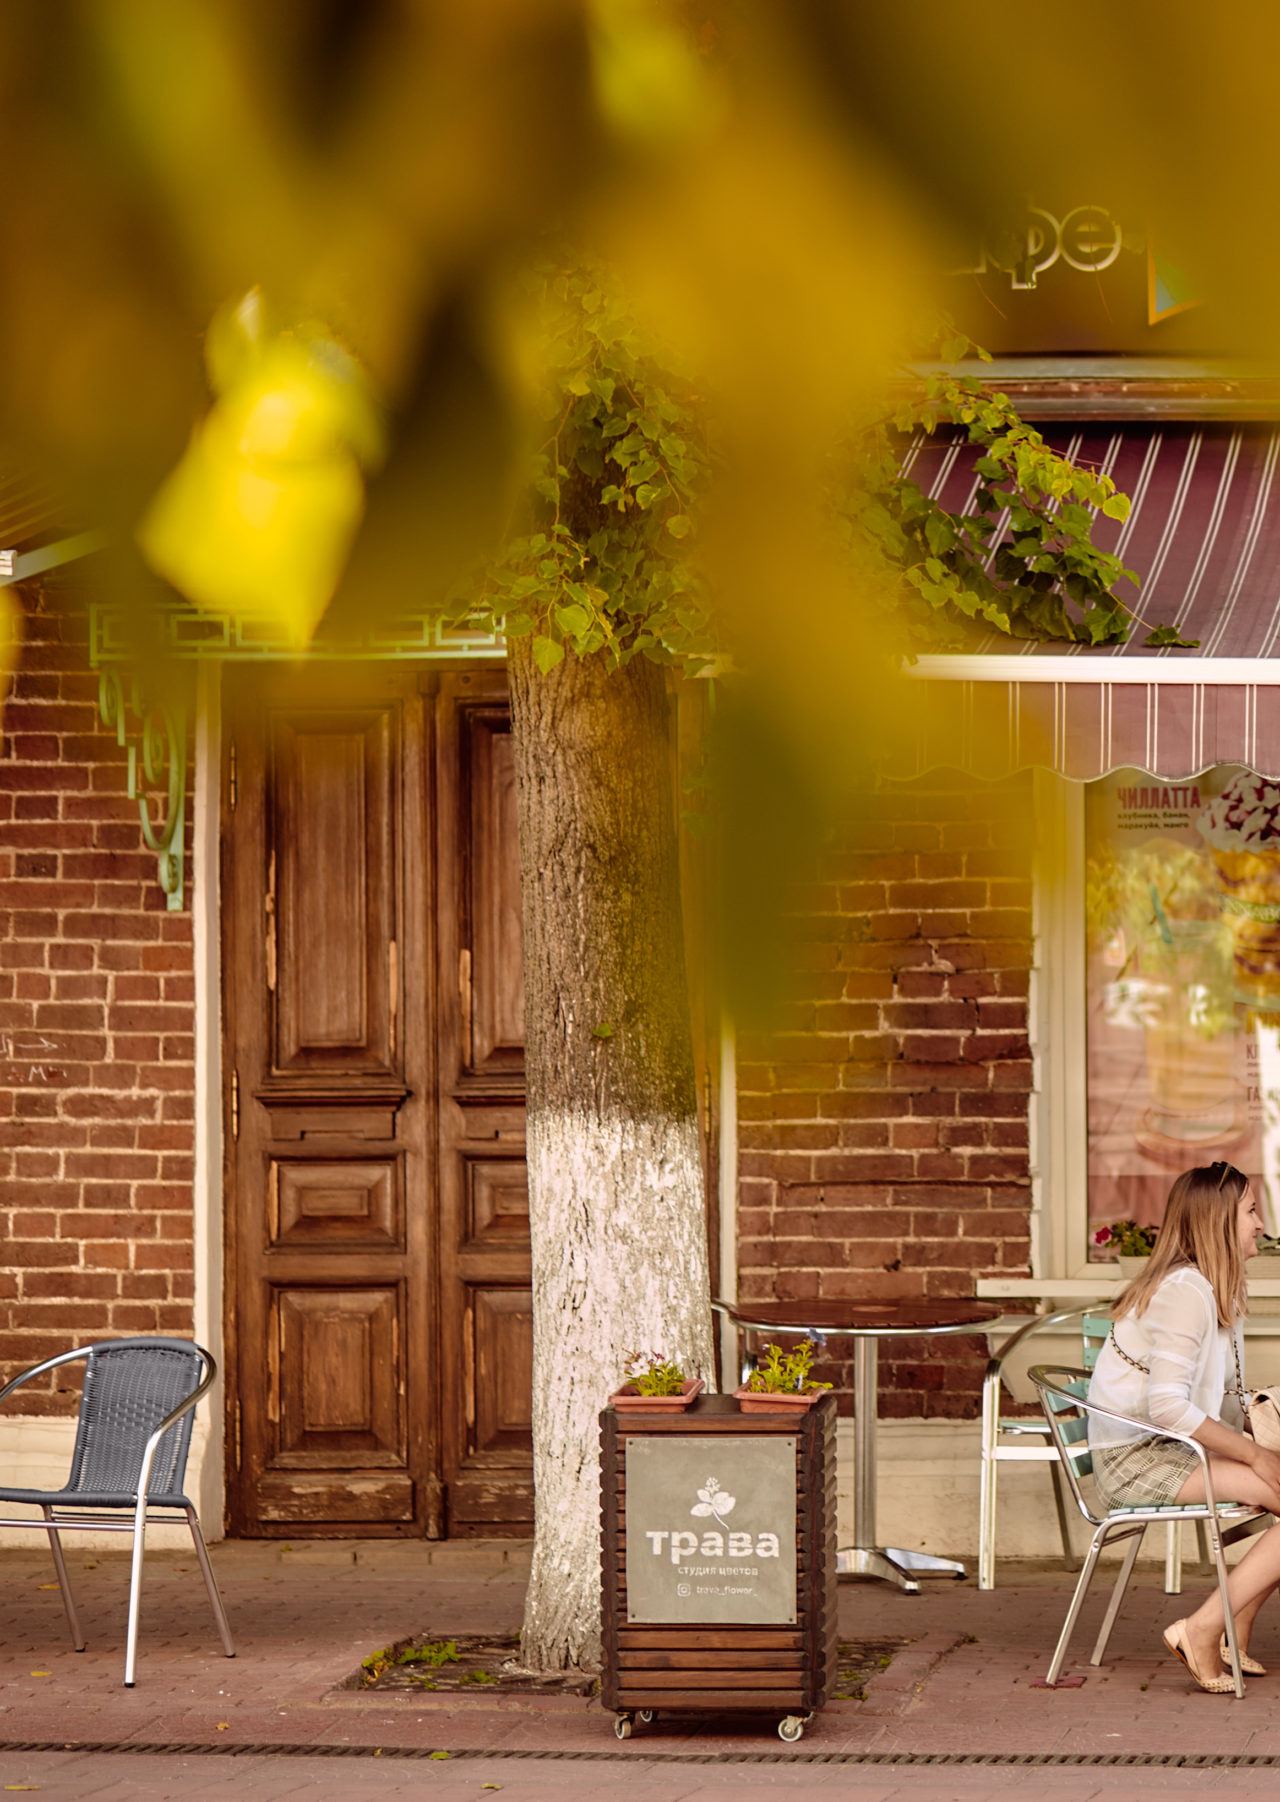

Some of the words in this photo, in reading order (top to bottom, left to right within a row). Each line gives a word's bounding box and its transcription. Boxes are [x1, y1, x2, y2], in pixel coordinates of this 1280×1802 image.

[1117, 787, 1201, 809] ЧИЛЛАТТА
[645, 1531, 780, 1565] трава
[678, 1567, 717, 1576] студия
[718, 1567, 759, 1576] цветов
